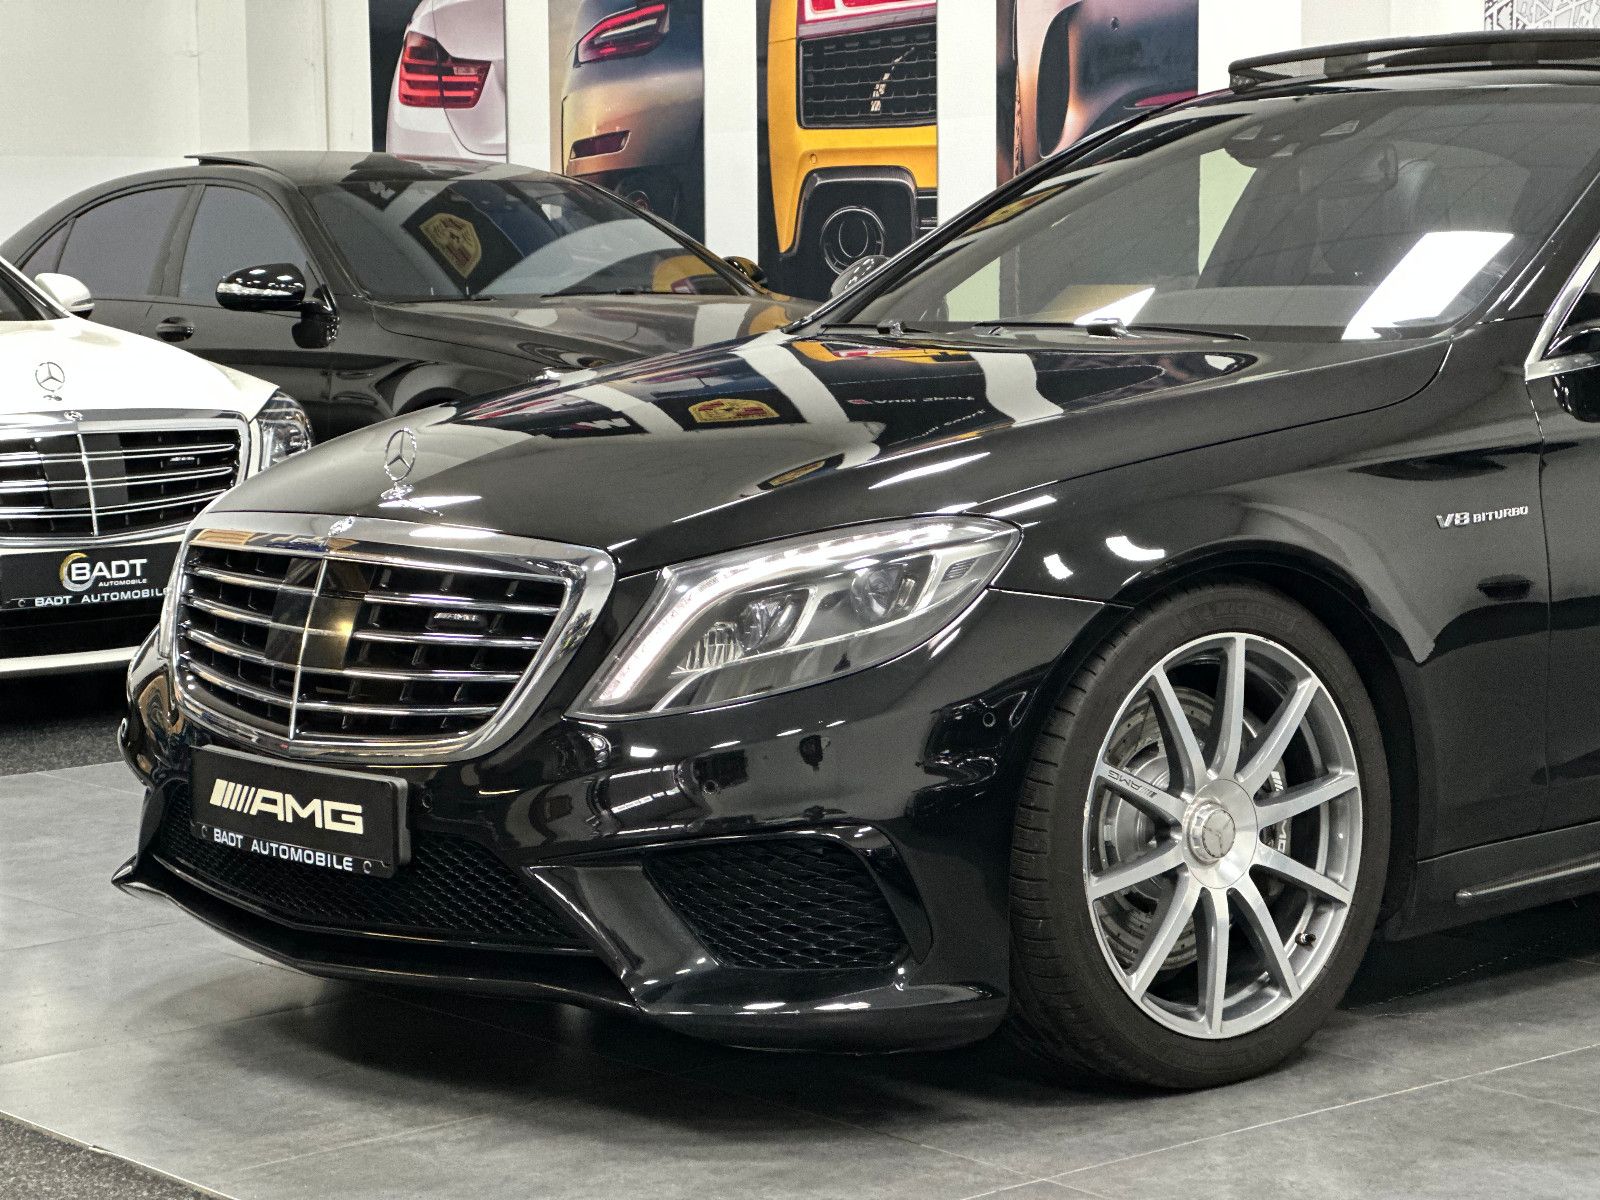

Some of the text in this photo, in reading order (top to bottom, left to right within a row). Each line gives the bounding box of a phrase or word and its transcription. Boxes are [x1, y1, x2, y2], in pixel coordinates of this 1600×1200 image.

[1436, 505, 1529, 529] V8 BITURBO
[70, 558, 148, 581] BADT
[98, 578, 147, 587] AUTOMOBILE
[34, 595, 73, 607] BADT
[1108, 769, 1142, 791] AMG
[249, 788, 364, 835] AMG
[213, 828, 354, 872] BADT AUTOMOBILE
